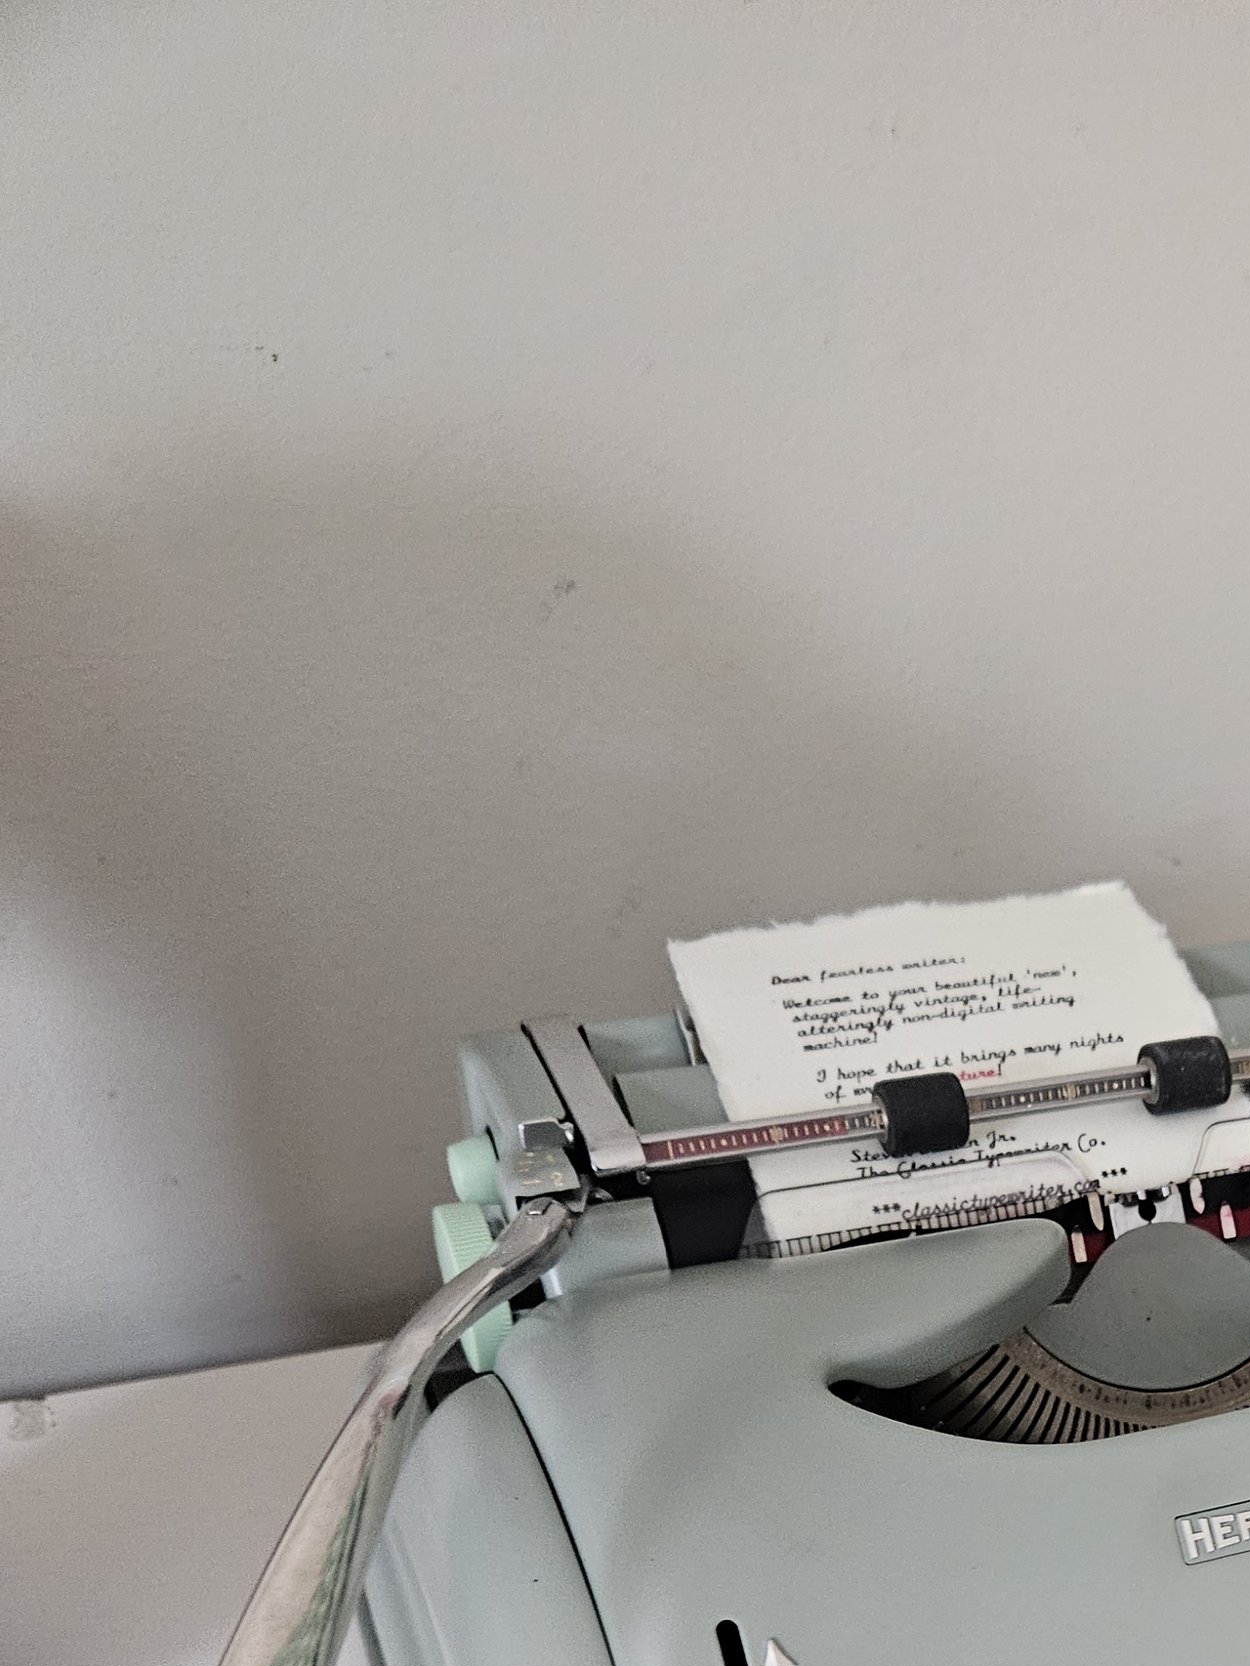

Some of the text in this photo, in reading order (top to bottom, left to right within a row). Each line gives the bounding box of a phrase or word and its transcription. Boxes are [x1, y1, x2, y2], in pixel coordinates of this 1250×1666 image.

[771, 975, 811, 986] Dear
[820, 965, 894, 984] fearless
[782, 995, 852, 1010] Welcome
[861, 990, 879, 1001] to
[888, 986, 926, 1003] your
[935, 972, 1017, 993] beautiful
[792, 1001, 906, 1024] staggeringly
[914, 991, 987, 1011] vintage,
[797, 995, 1075, 1038] alteringly non-digital writing
[803, 1031, 878, 1052] machine!
[837, 1065, 878, 1085] hope
[886, 1058, 925, 1074] that
[933, 1055, 951, 1068] it
[960, 1046, 1017, 1066] brings
[1024, 1040, 1062, 1056] many
[1069, 1034, 1124, 1051] nights
[824, 1085, 844, 1104] of
[987, 1131, 1017, 1151] Jr.
[1077, 1133, 1106, 1153] Co.
